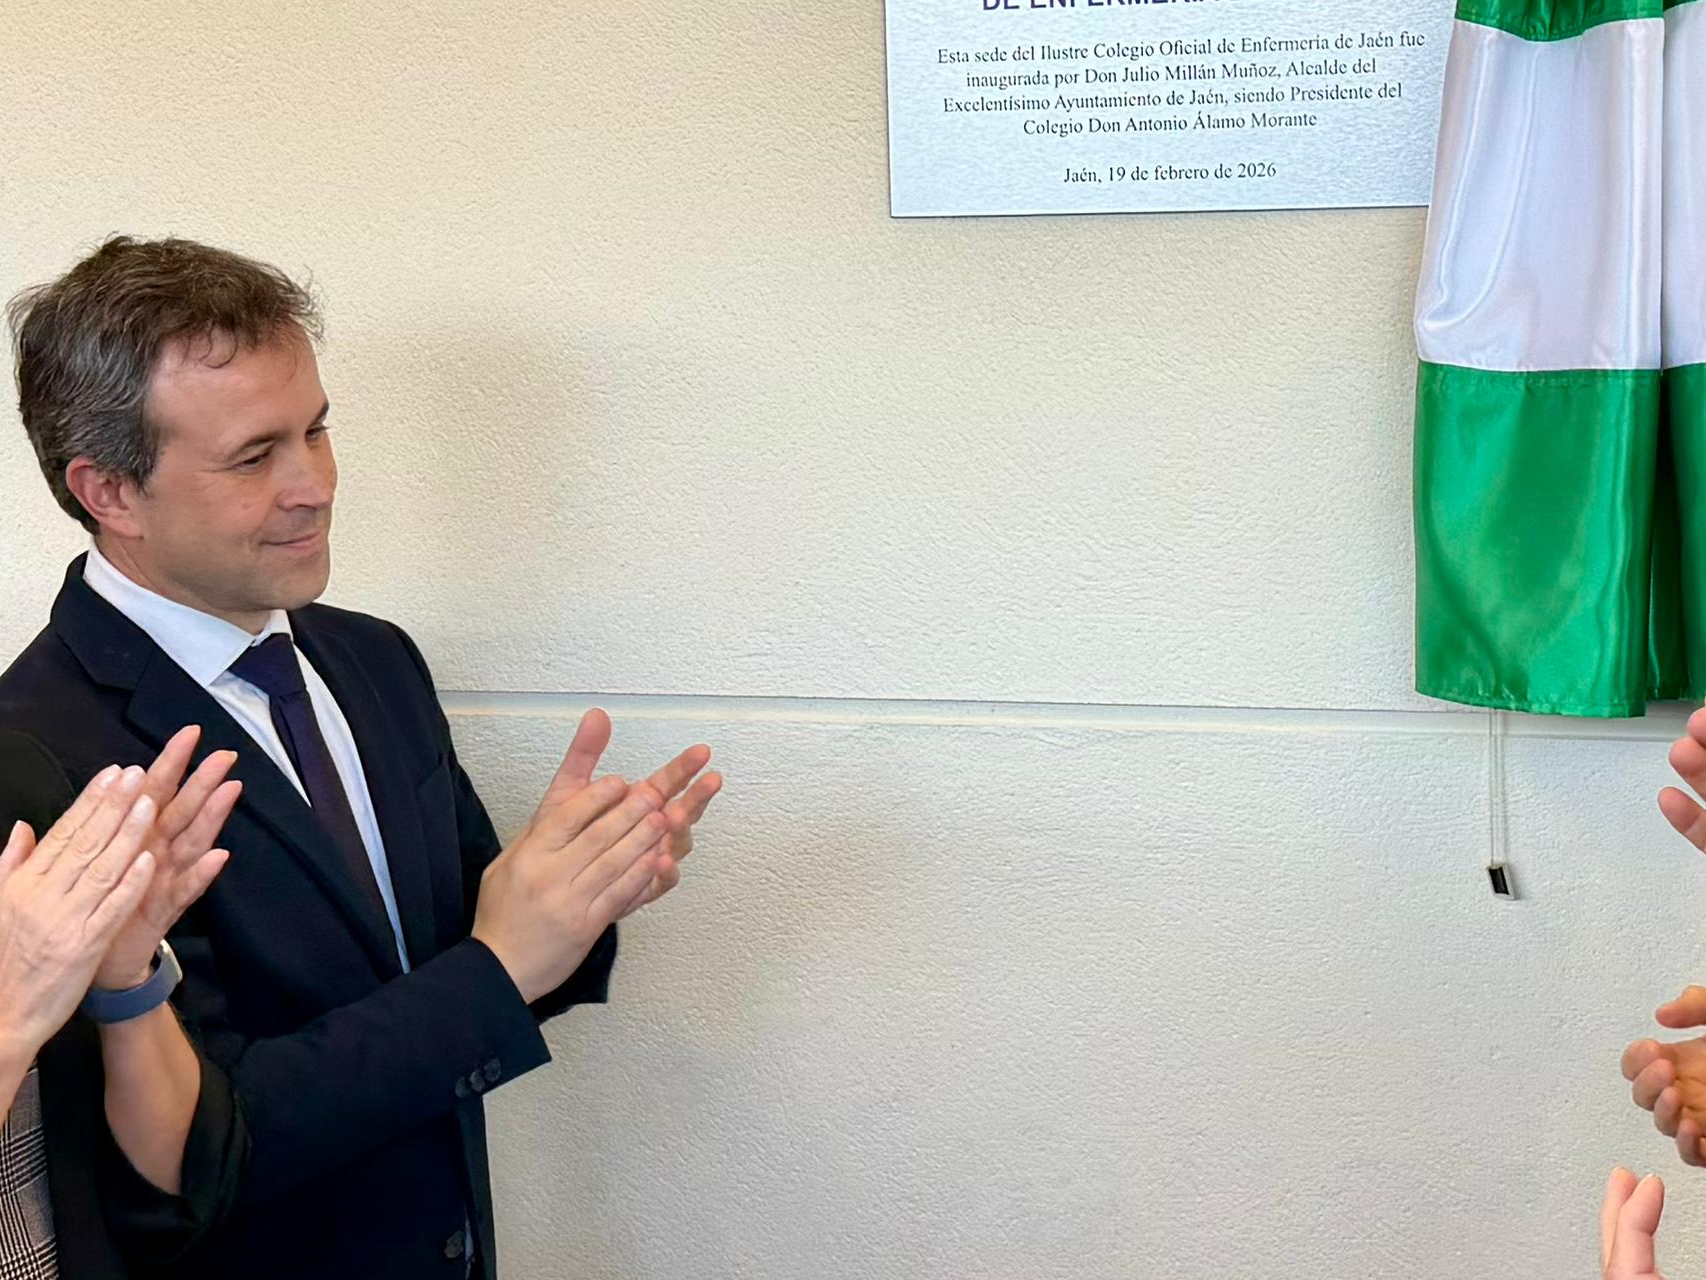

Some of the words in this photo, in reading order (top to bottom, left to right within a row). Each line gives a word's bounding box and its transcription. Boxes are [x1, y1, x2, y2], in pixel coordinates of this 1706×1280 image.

[938, 49, 969, 64] Esta
[974, 47, 1007, 62] sede
[1012, 46, 1035, 61] del
[1041, 45, 1088, 60] Ilustre
[1093, 42, 1154, 60] Colegio
[1159, 39, 1211, 56] Oficial
[1217, 38, 1236, 53] de
[1241, 34, 1329, 53] Enfermería
[1334, 33, 1353, 48] de
[1358, 31, 1394, 48] Jaén
[1400, 30, 1425, 47] fue
[966, 70, 1049, 90] inaugurada
[1054, 72, 1080, 88] por
[1085, 68, 1117, 84] Don
[1122, 65, 1159, 82] Julio
[1165, 63, 1216, 80] Millán
[1221, 62, 1282, 80] Muñoz,
[1285, 59, 1347, 76] Alcalde
[1352, 57, 1377, 73] del
[943, 95, 1051, 112] Excelentísimo
[1054, 91, 1161, 112] Ayuntamiento
[1166, 90, 1184, 106] de
[1189, 89, 1229, 106] Jaén,
[1234, 86, 1285, 103] siendo
[1291, 84, 1373, 102] Presidente
[1377, 82, 1402, 99] del
[1023, 118, 1083, 137] Colegio
[1089, 117, 1121, 133] Don
[1125, 114, 1188, 132] Antonio
[1193, 110, 1246, 131] Álamo
[1251, 111, 1318, 129] Morante
[1064, 167, 1102, 184] Jaén,
[1108, 166, 1126, 183] 19
[1131, 166, 1148, 181] de
[1154, 164, 1209, 182] febrero
[1214, 162, 1233, 180] de
[1237, 161, 1277, 179] 2026
